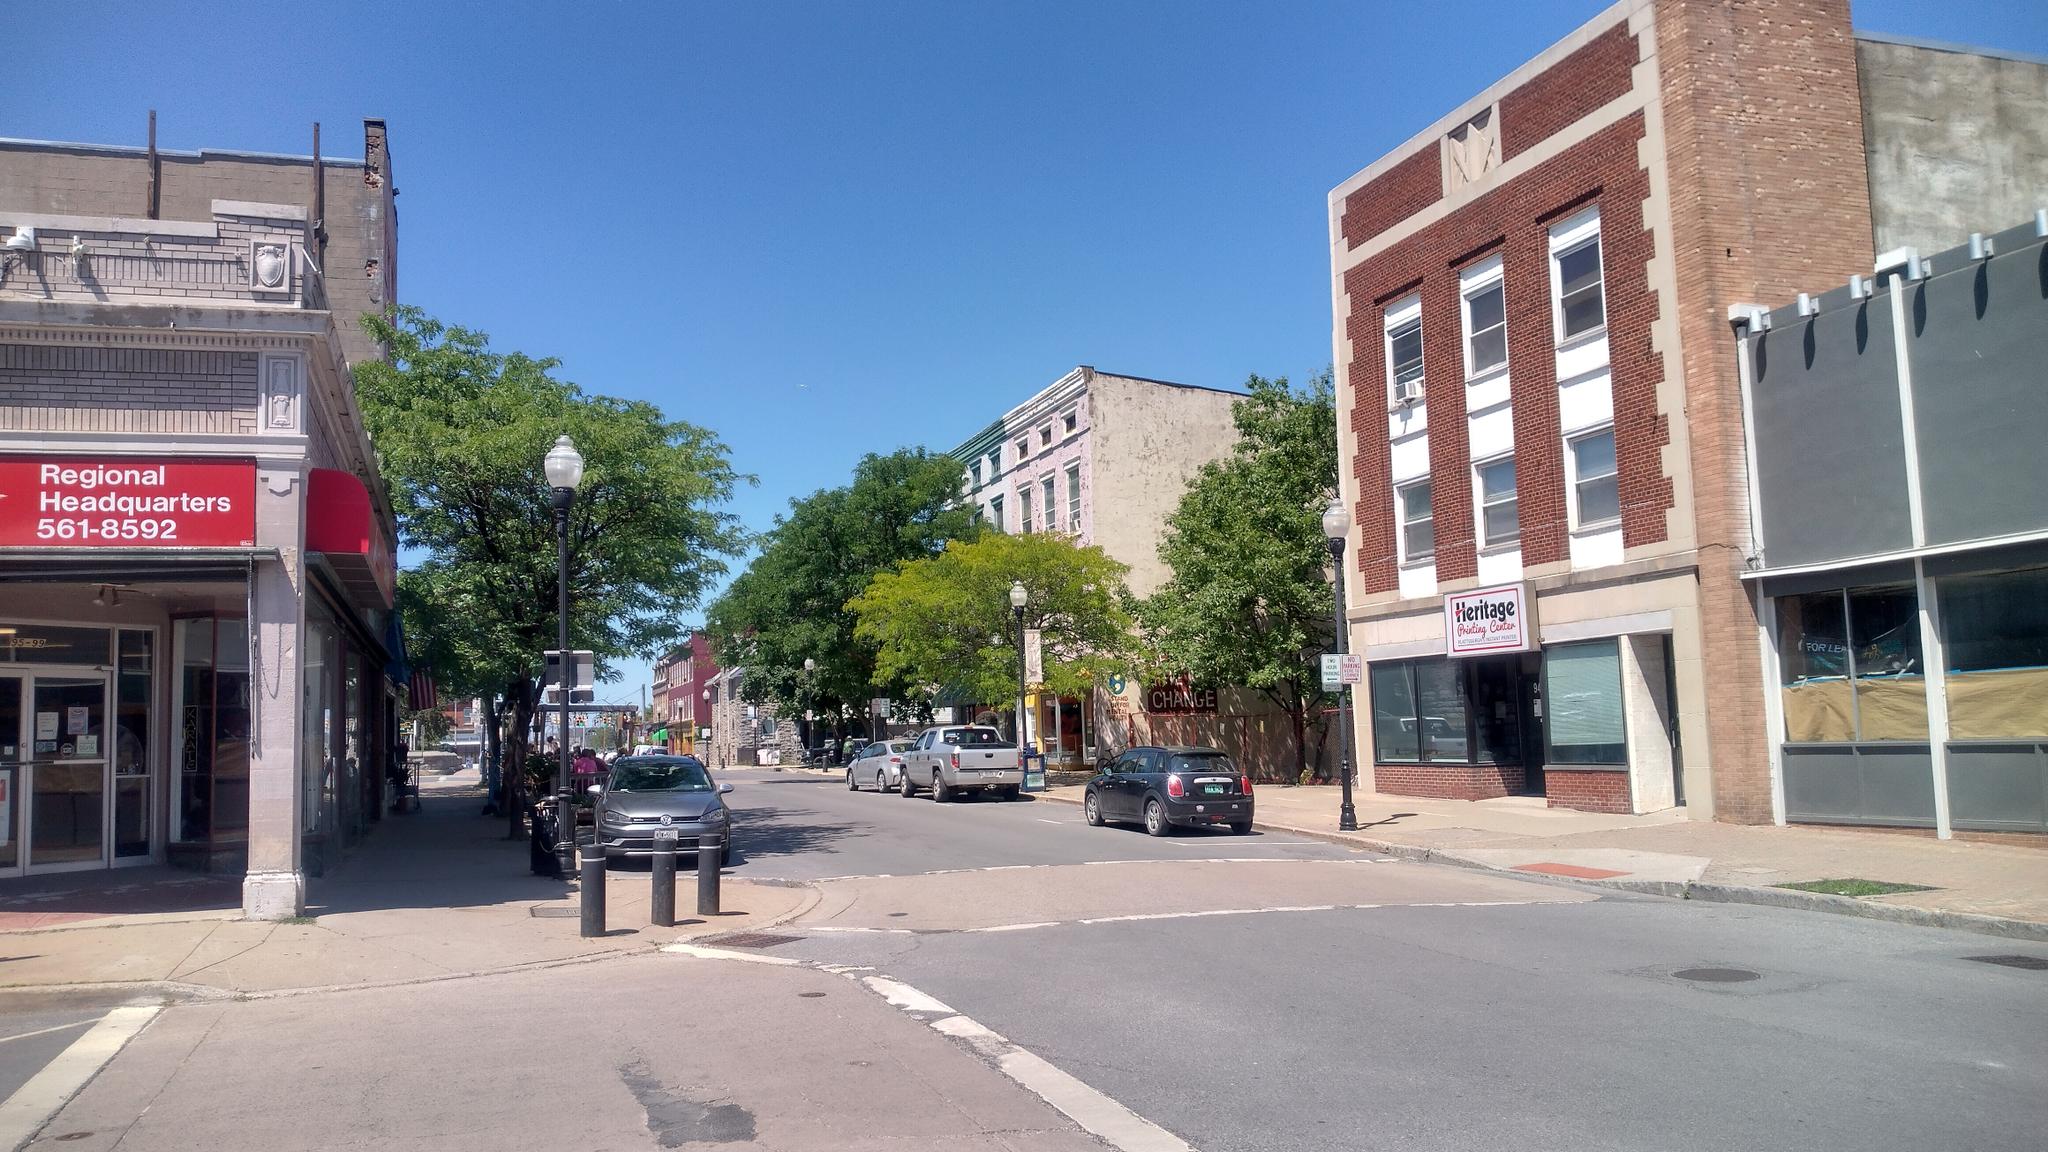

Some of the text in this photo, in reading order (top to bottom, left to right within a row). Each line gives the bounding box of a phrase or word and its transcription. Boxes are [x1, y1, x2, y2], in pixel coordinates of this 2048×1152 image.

[40, 464, 165, 489] Regional
[40, 492, 231, 516] Headquarters
[36, 519, 177, 539] 561-8592
[1455, 599, 1515, 622] Heritage
[1457, 620, 1516, 639] Printing Center
[1806, 642, 1826, 652] FOR
[1152, 689, 1215, 709] CHANGE
